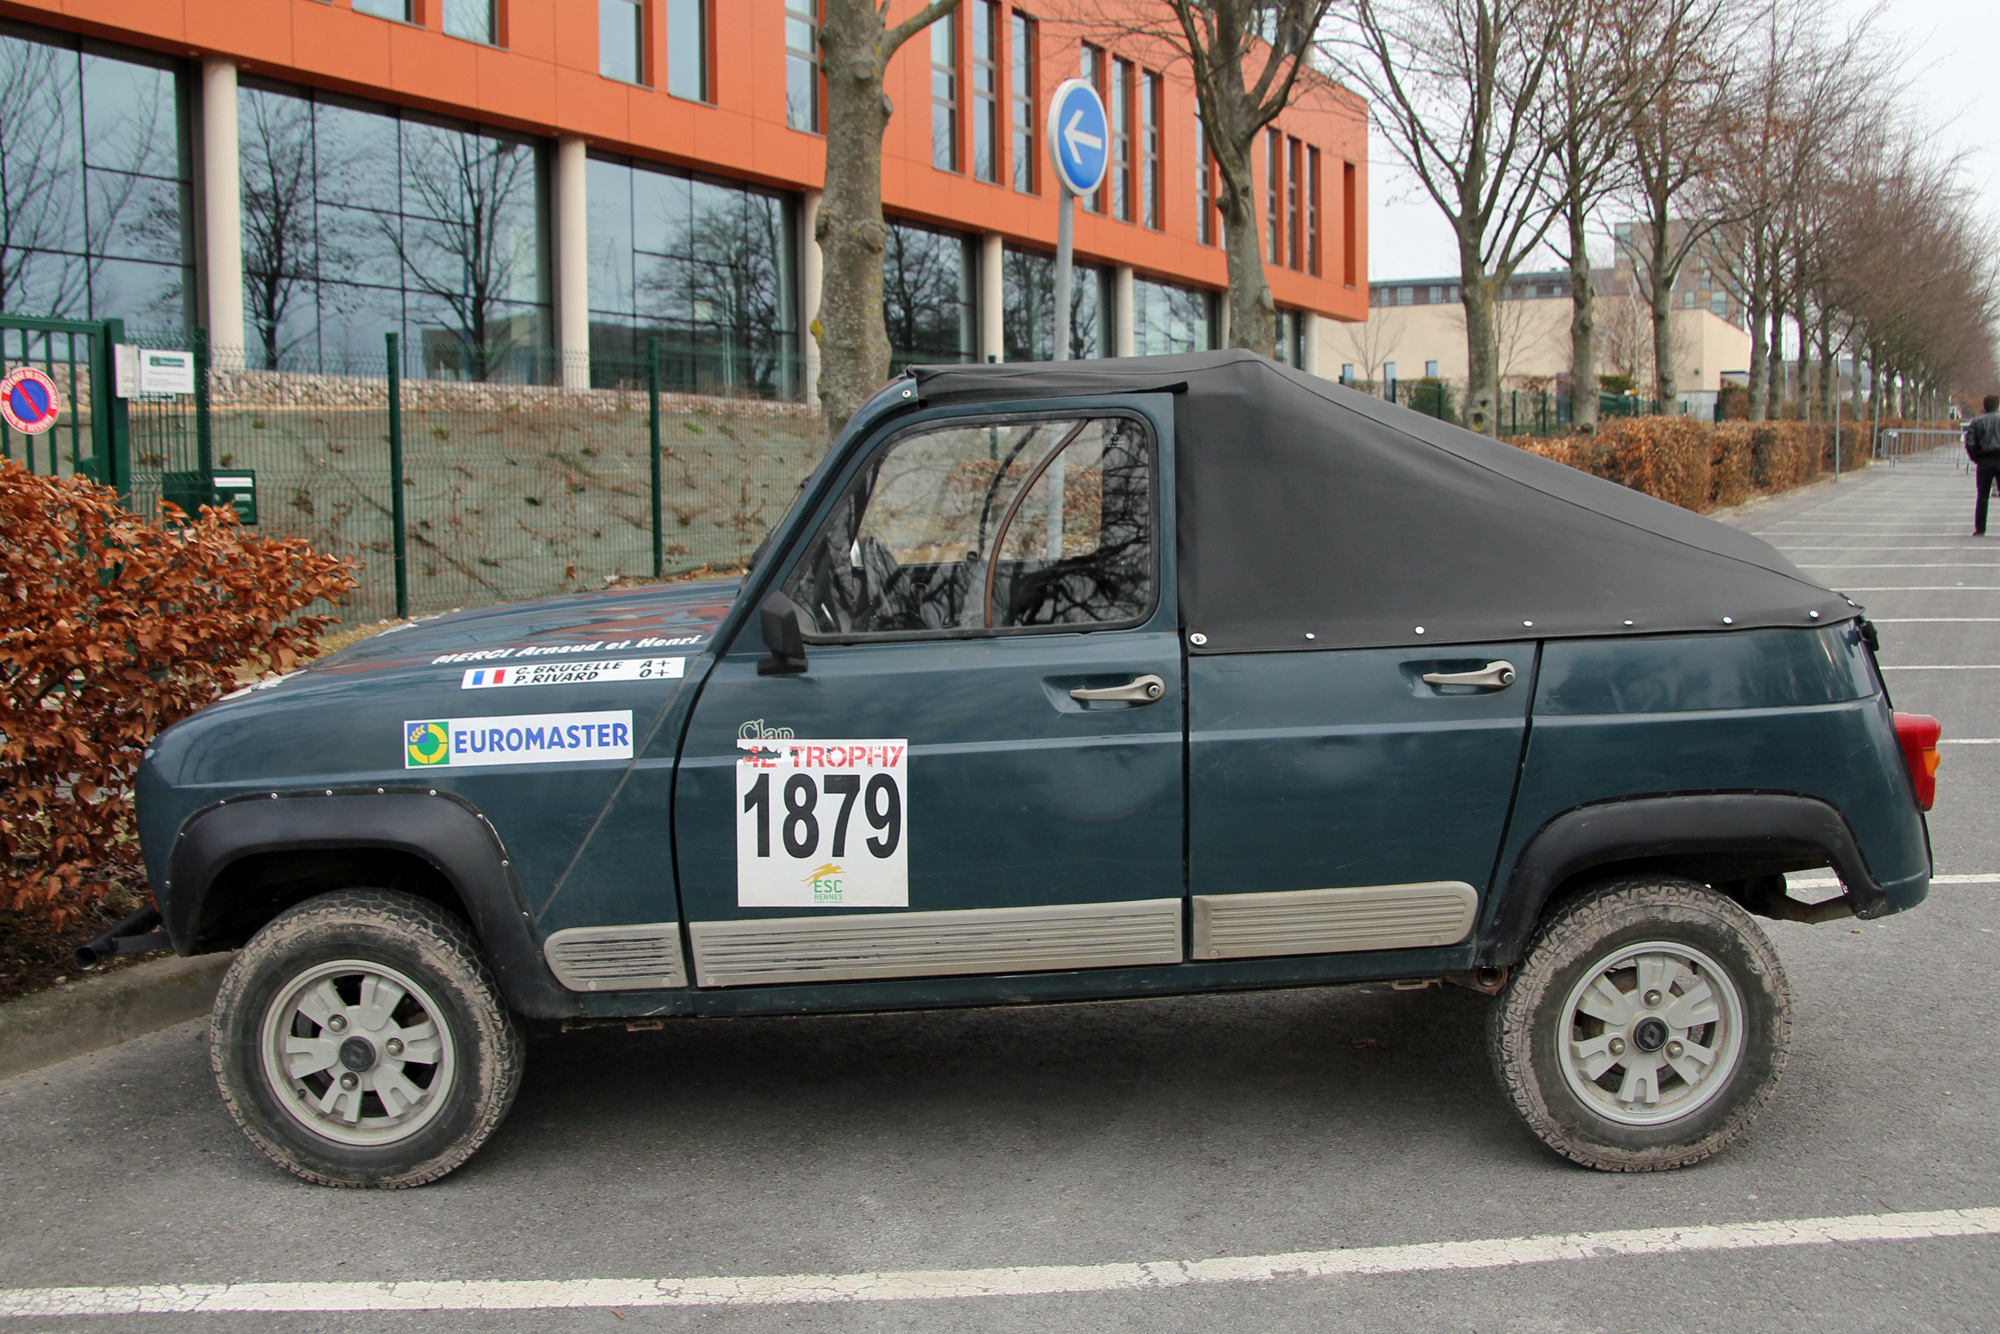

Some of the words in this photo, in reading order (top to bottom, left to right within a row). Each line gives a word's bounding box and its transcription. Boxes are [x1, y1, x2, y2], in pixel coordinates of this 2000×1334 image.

[431, 648, 516, 665] MERCI
[514, 641, 604, 658] Arnaud
[605, 640, 631, 650] et
[635, 634, 702, 648] Henri
[455, 722, 629, 754] EUROMASTER
[789, 745, 905, 768] TROPHY
[744, 773, 901, 859] 1879
[814, 879, 843, 893] ESC
[814, 893, 844, 901] RENNES
